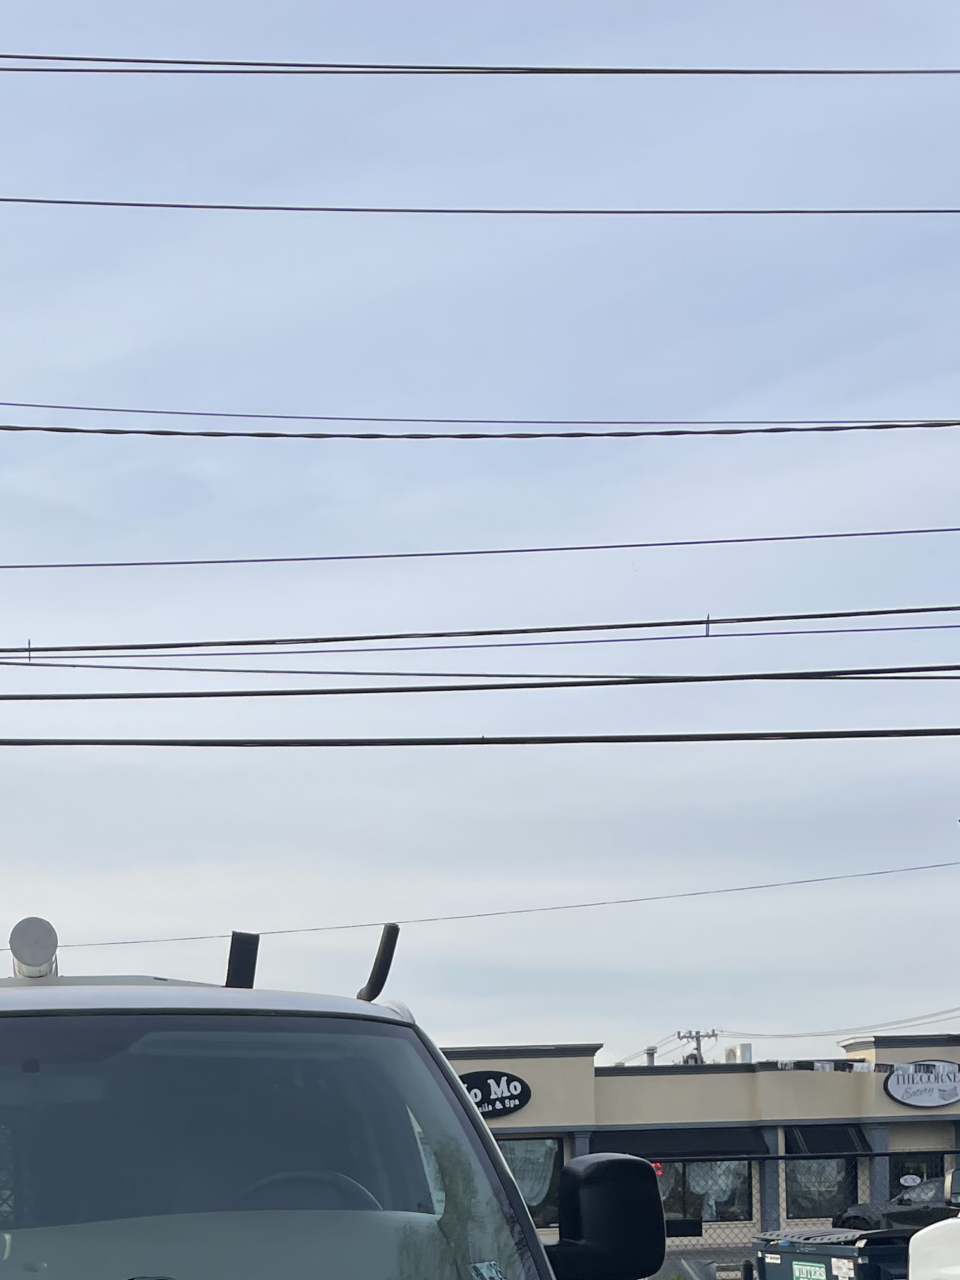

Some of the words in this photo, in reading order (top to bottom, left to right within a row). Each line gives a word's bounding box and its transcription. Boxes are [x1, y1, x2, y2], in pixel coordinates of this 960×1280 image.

[894, 1073, 919, 1086] THE
[464, 1083, 482, 1103] o
[487, 1076, 522, 1099] Mo
[495, 1101, 503, 1109] &
[505, 1099, 519, 1108] Spa
[794, 1265, 825, 1280] WINTERS
